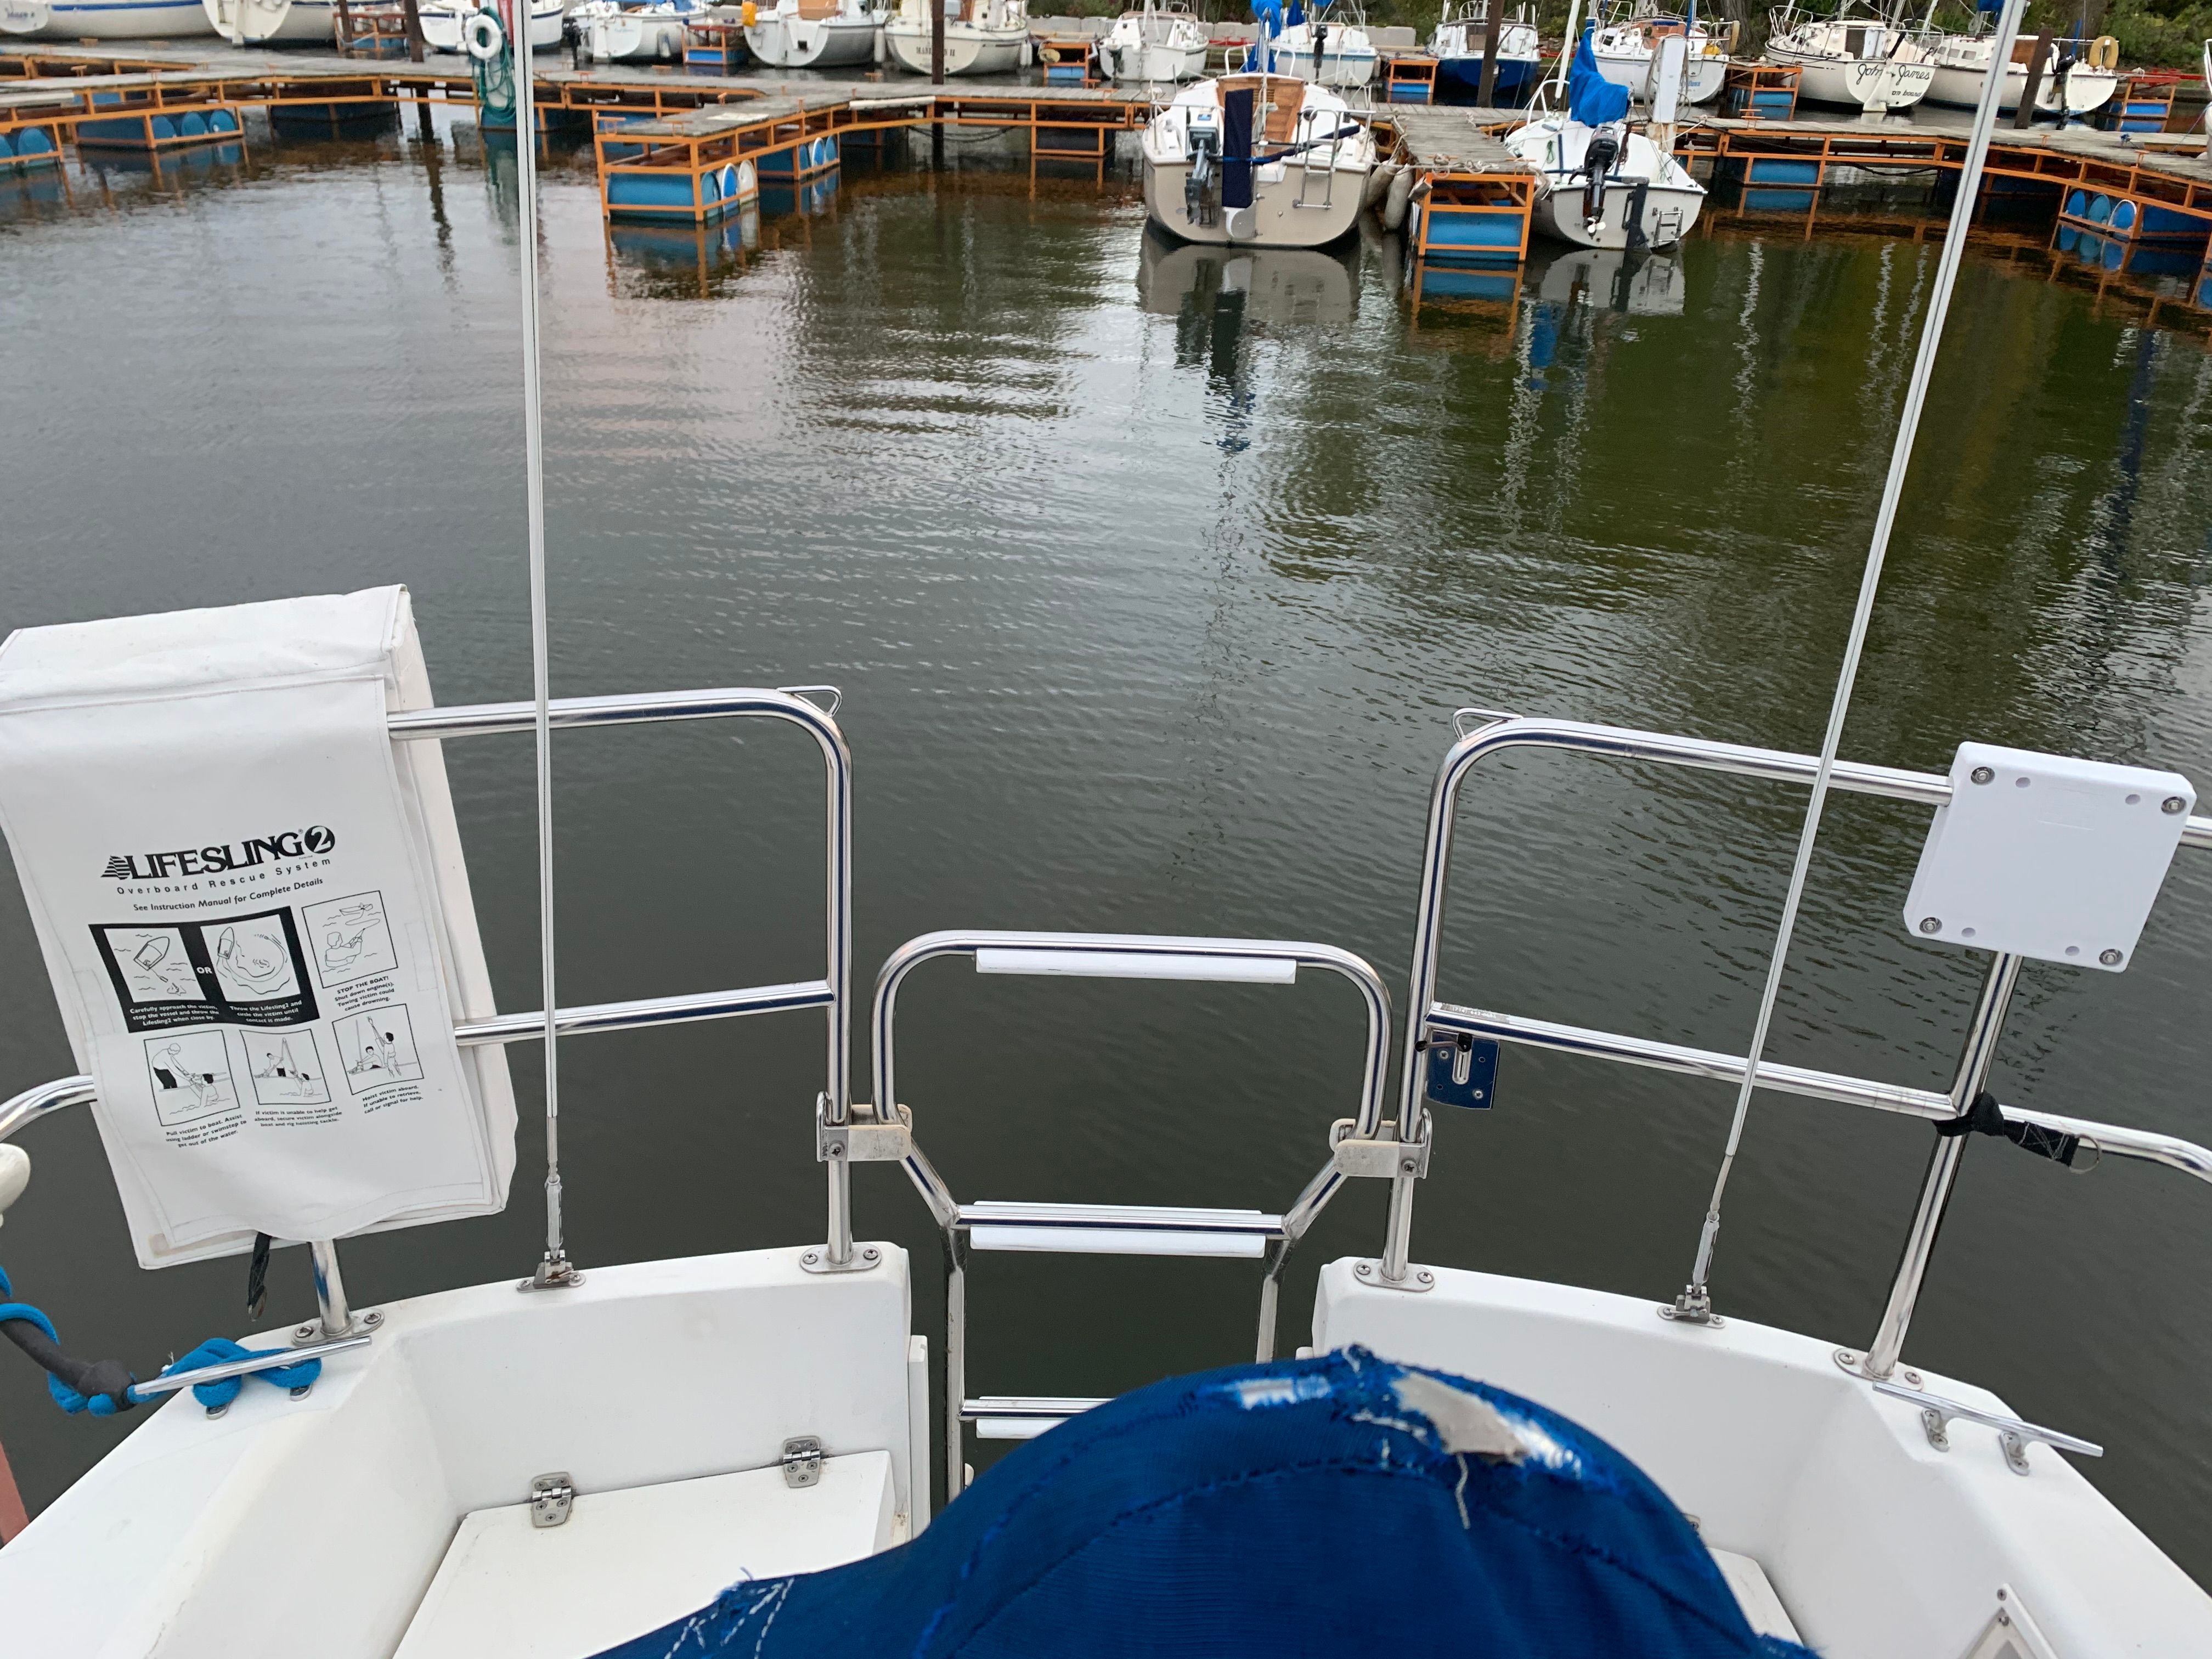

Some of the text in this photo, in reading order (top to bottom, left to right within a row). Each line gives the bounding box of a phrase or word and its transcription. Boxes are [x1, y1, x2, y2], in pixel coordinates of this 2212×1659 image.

[1896, 65, 1929, 86] James
[117, 859, 330, 894] Overboard Rescue System
[199, 897, 231, 907] Manual
[234, 895, 246, 904] for
[250, 886, 291, 900] Complete
[294, 878, 323, 889] Details
[337, 986, 353, 994] STOP
[367, 982, 394, 991] engine(s).
[337, 998, 358, 1007] Towing
[362, 997, 390, 1006] drowning.
[370, 1097, 388, 1105] unable
[211, 1122, 239, 1134] swimstep
